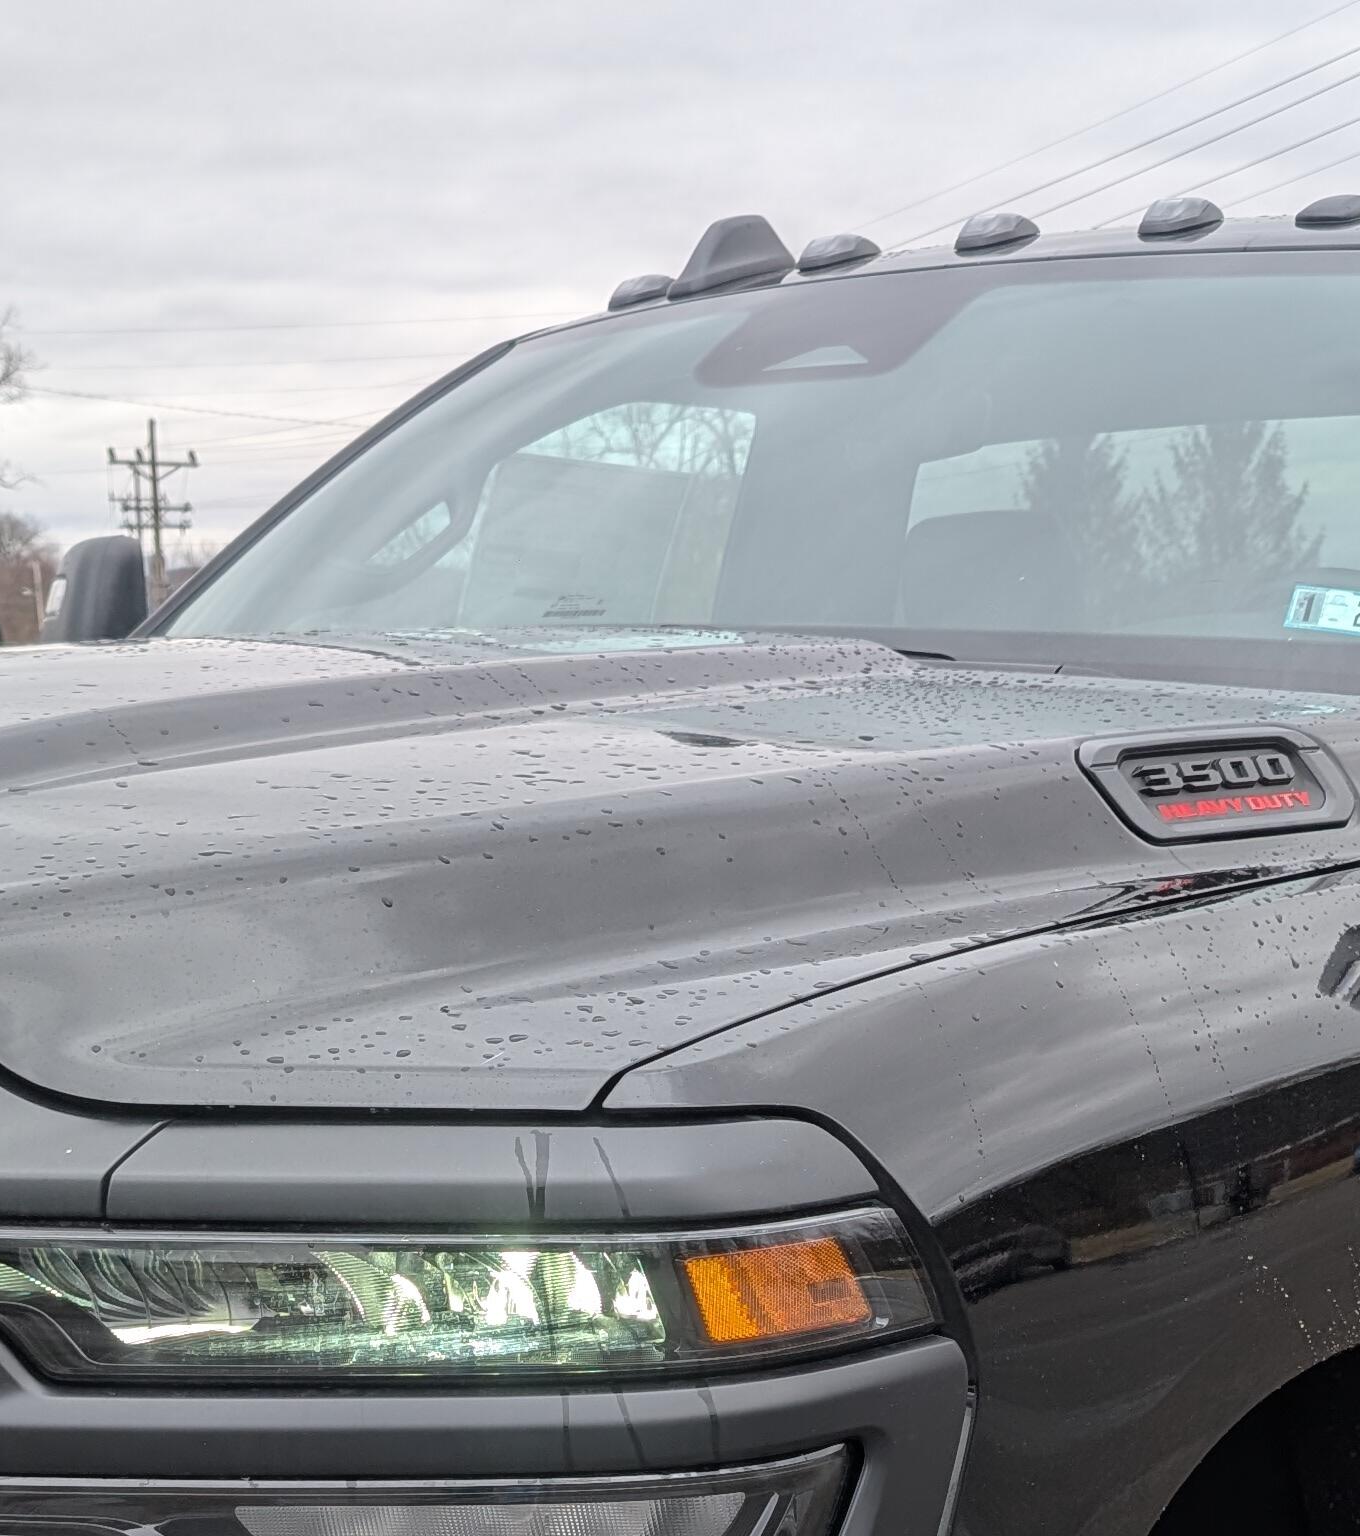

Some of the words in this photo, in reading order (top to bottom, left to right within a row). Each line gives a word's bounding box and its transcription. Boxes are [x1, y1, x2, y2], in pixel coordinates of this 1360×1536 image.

[1131, 753, 1295, 798] 3500
[1156, 796, 1242, 823] HEAVY
[1247, 790, 1311, 811] DUTY
